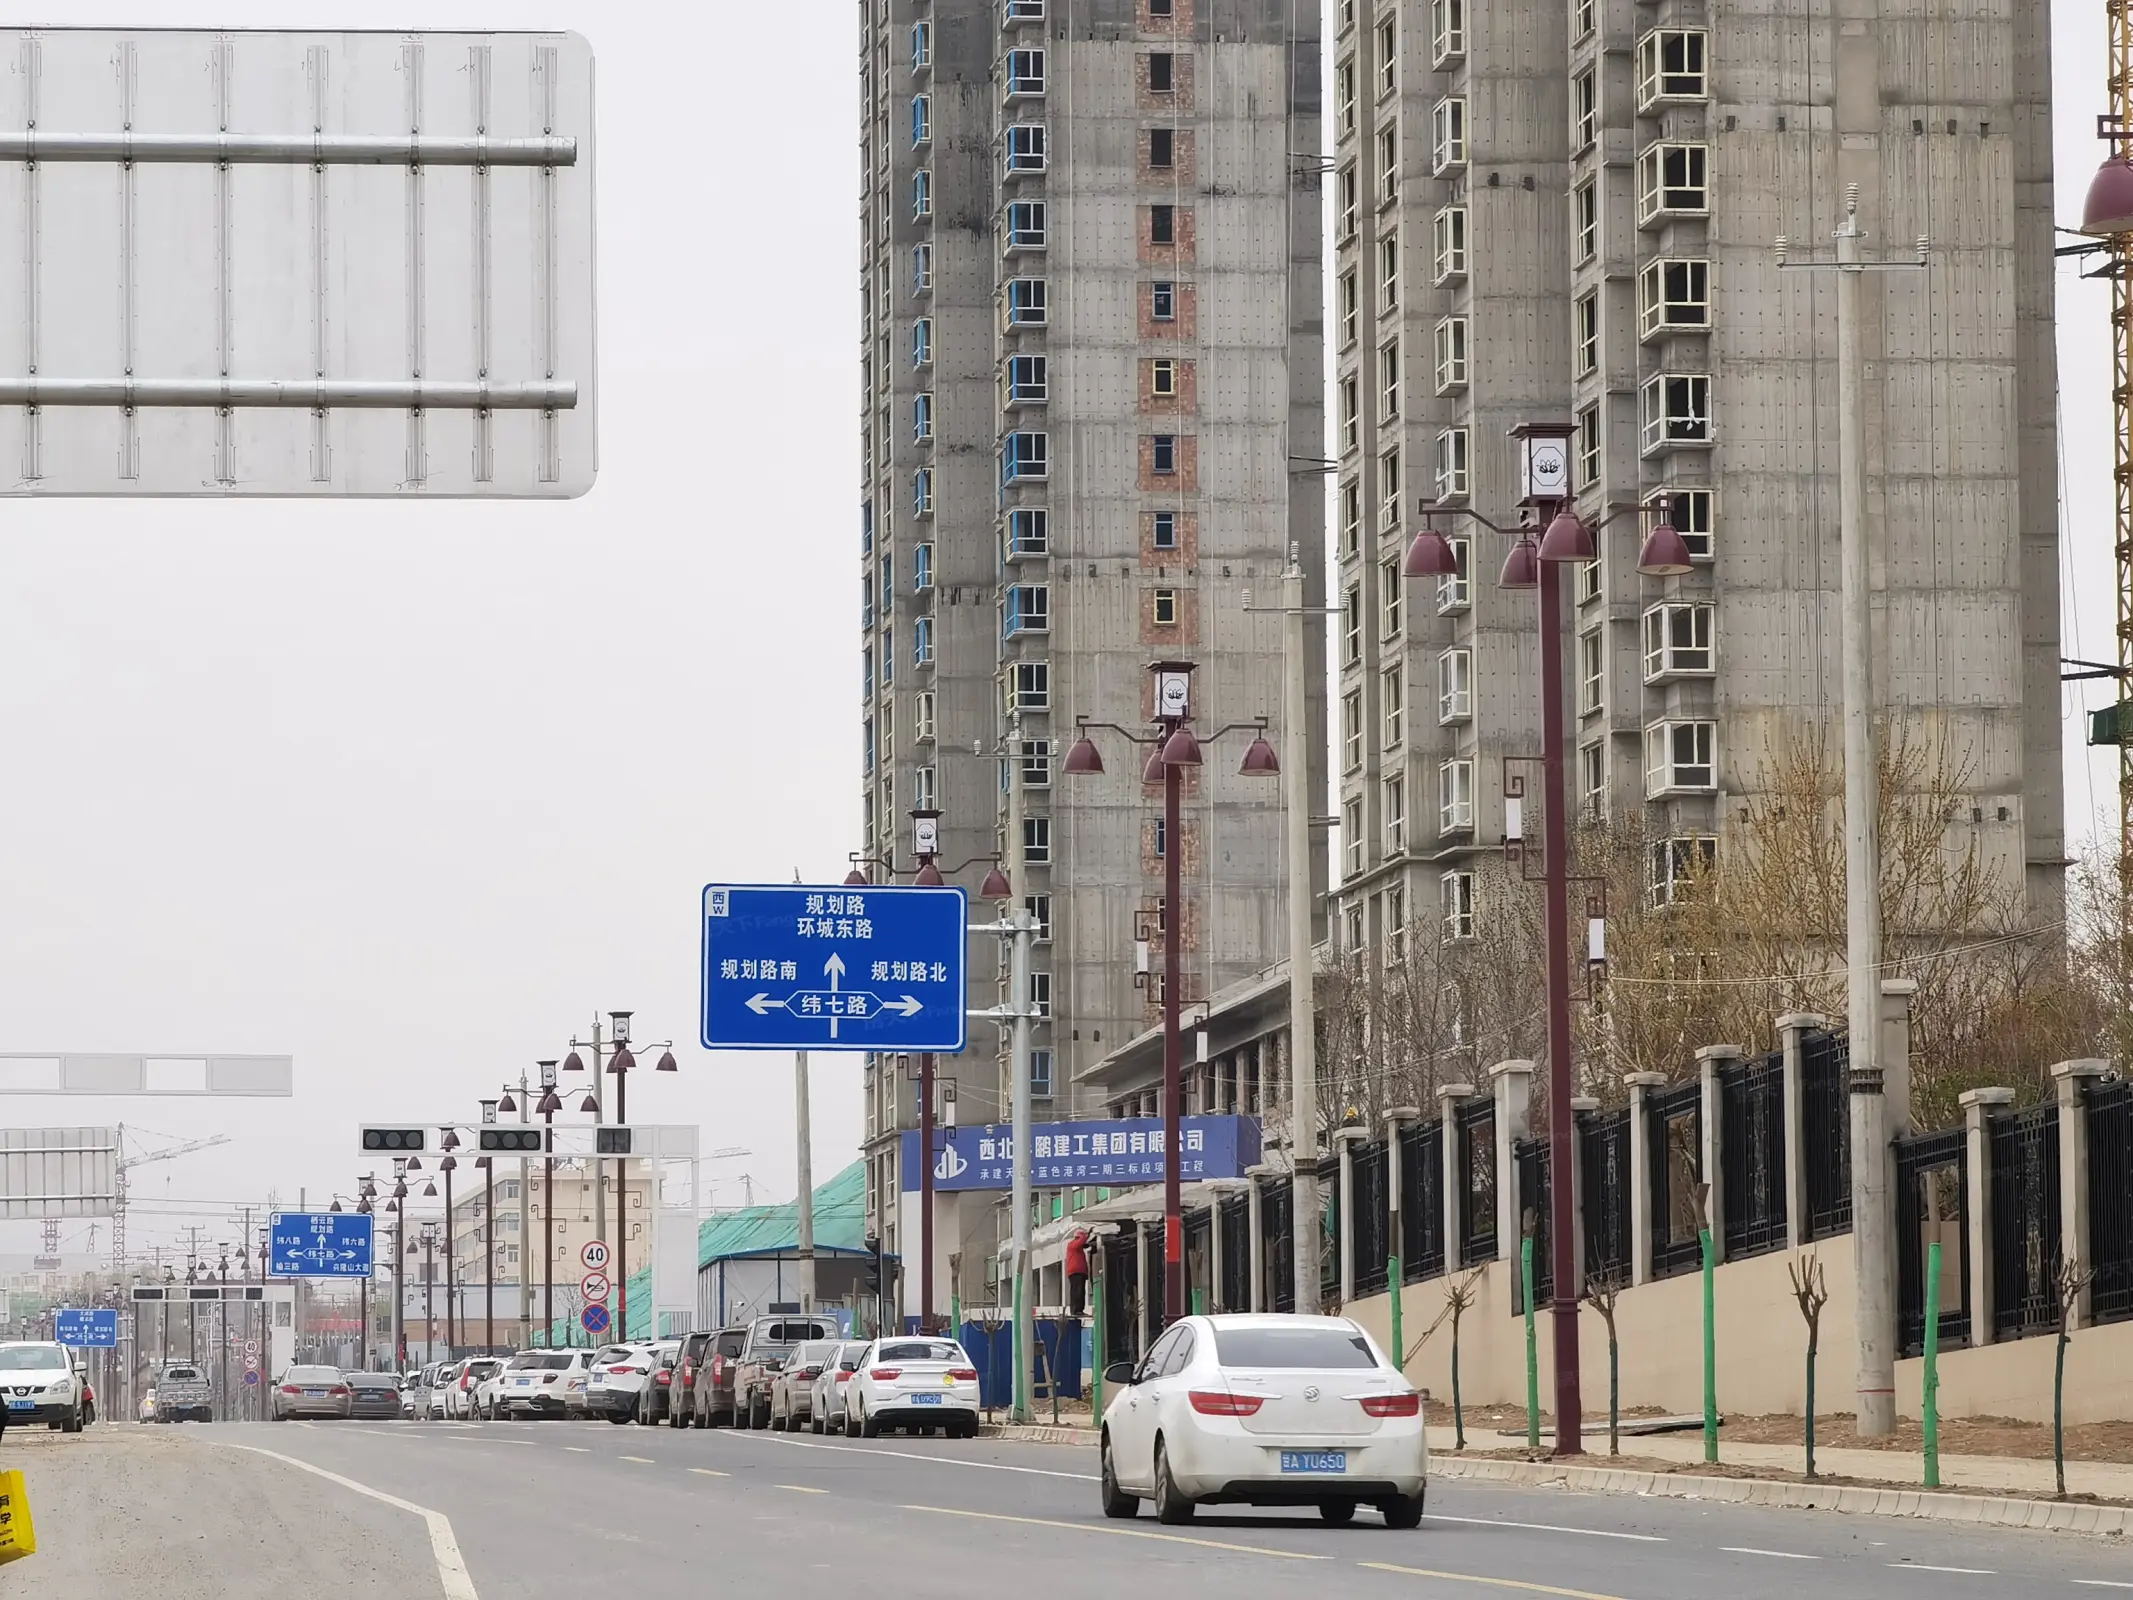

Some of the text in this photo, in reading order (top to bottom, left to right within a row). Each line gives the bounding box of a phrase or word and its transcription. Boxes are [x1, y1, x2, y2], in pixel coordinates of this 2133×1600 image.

[711, 891, 726, 905] 西
[805, 894, 866, 916] 规划路
[712, 905, 725, 915] W
[797, 918, 873, 939] 环城东路
[720, 959, 797, 980] 规划路南
[871, 961, 948, 983] 规划路北
[801, 994, 868, 1015] 纬七路
[979, 1129, 1204, 1161] 西北鹏建工集团有限司
[587, 1248, 604, 1262] 40
[247, 1342, 256, 1352] 40
